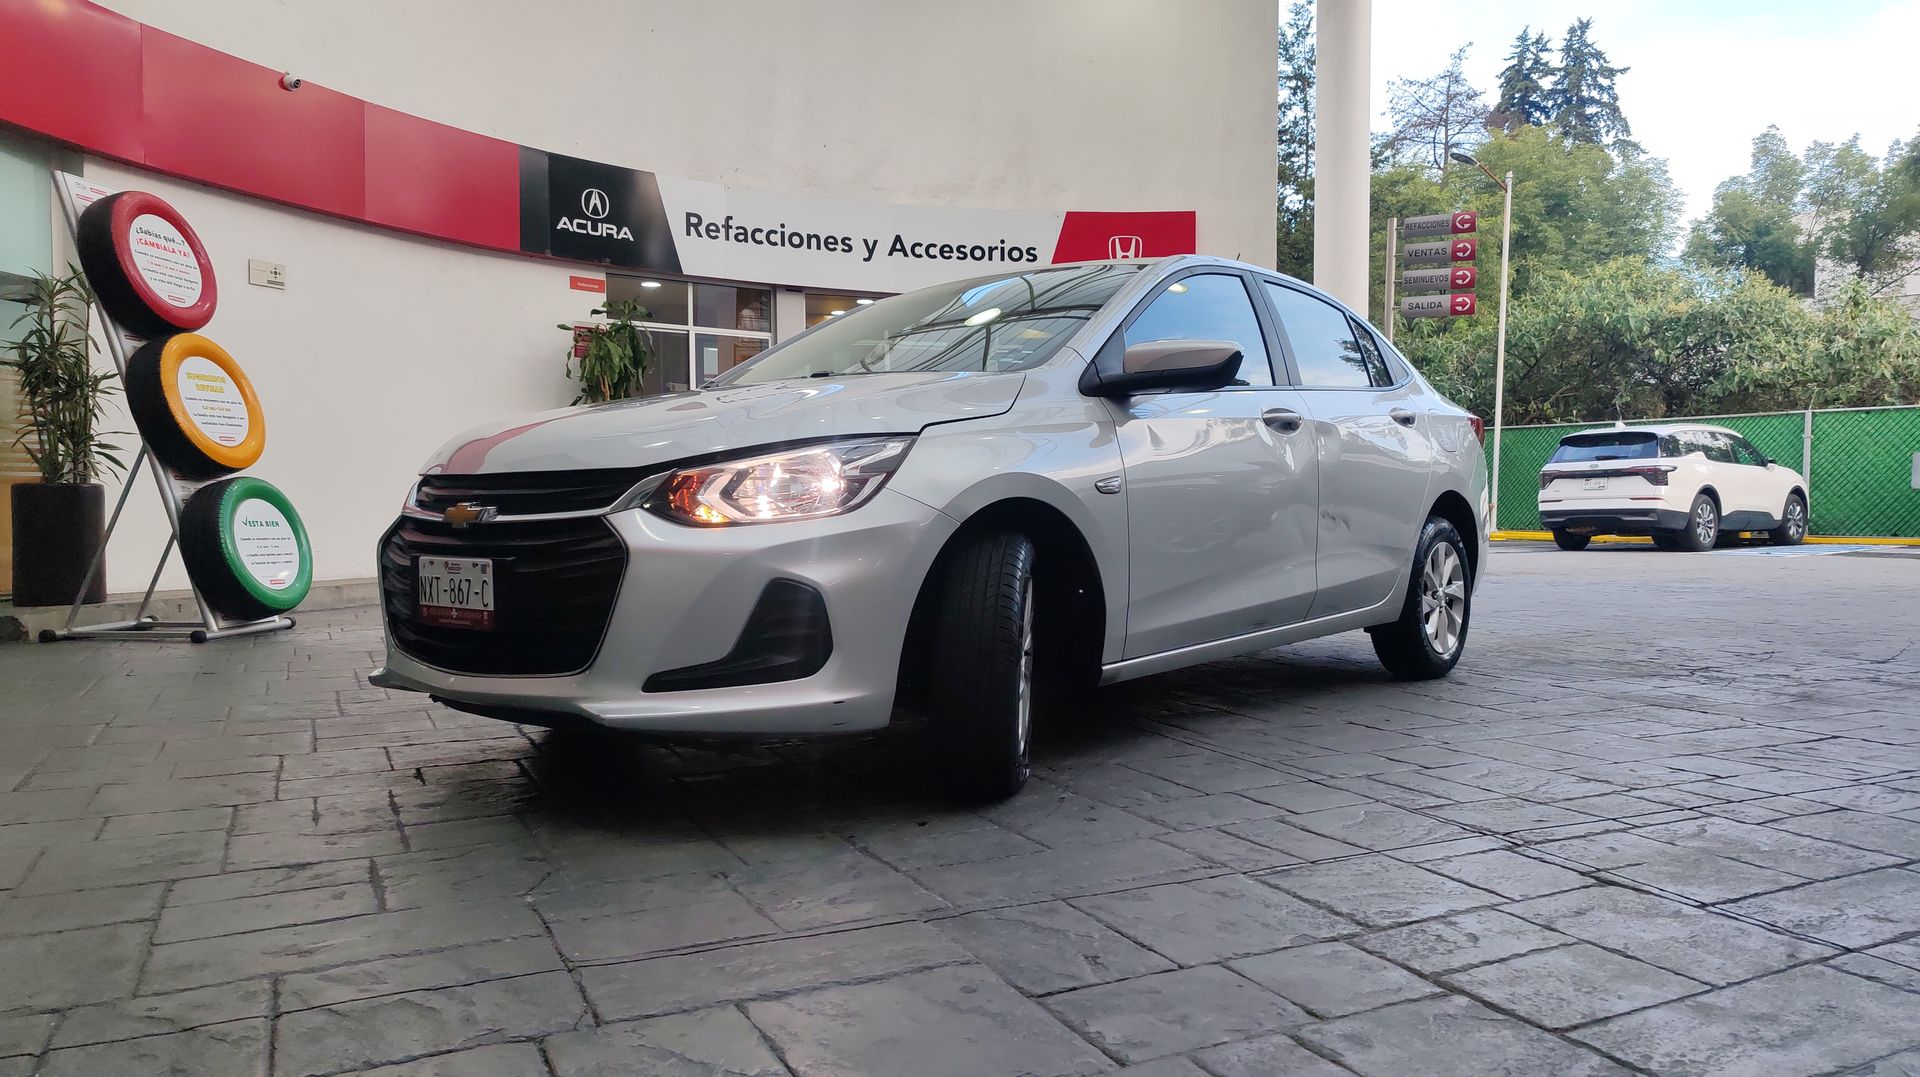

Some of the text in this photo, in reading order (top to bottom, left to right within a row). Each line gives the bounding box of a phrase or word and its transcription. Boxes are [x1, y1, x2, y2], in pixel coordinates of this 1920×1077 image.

[556, 216, 635, 242] ACURA
[1405, 219, 1450, 231] REFACCIONES
[685, 211, 1038, 263] Refacciones y Accesorios
[1407, 247, 1448, 258] VENTAS
[1403, 274, 1449, 285] SEMINUEVOS
[1407, 301, 1443, 311] SALIDA
[264, 520, 280, 528] BIEN
[420, 575, 489, 607] NXT-867-C
